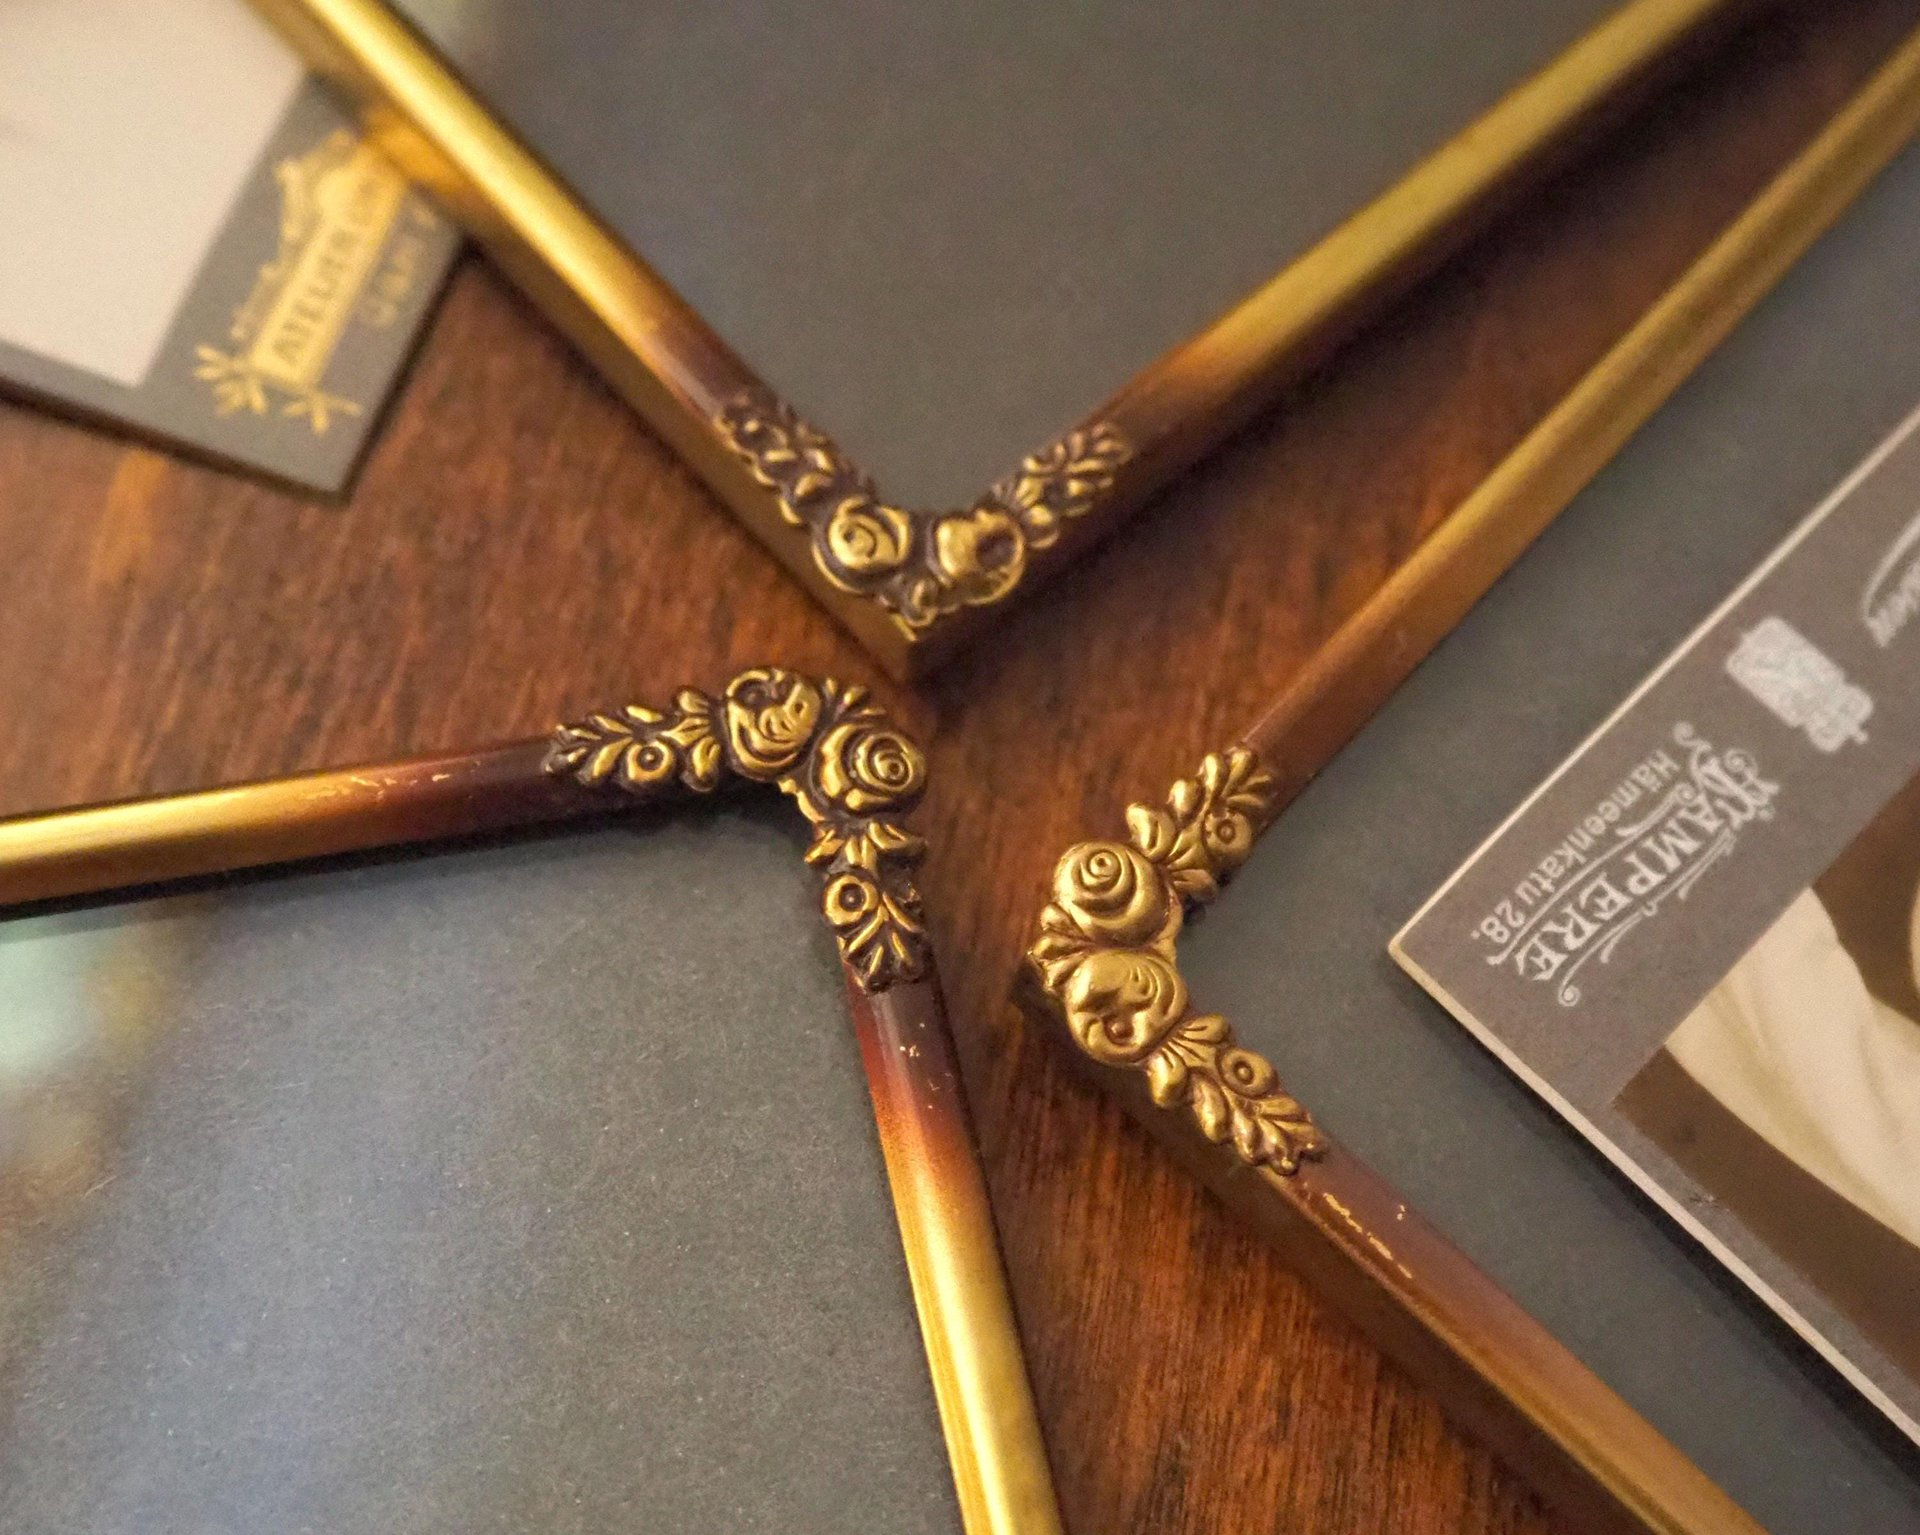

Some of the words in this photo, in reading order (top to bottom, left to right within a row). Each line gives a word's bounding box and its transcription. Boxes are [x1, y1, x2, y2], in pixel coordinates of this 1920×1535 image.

[1514, 750, 1680, 906] Hämeenkatu
[1515, 727, 1779, 980] TAMPERE
[1470, 899, 1526, 944] 28.
